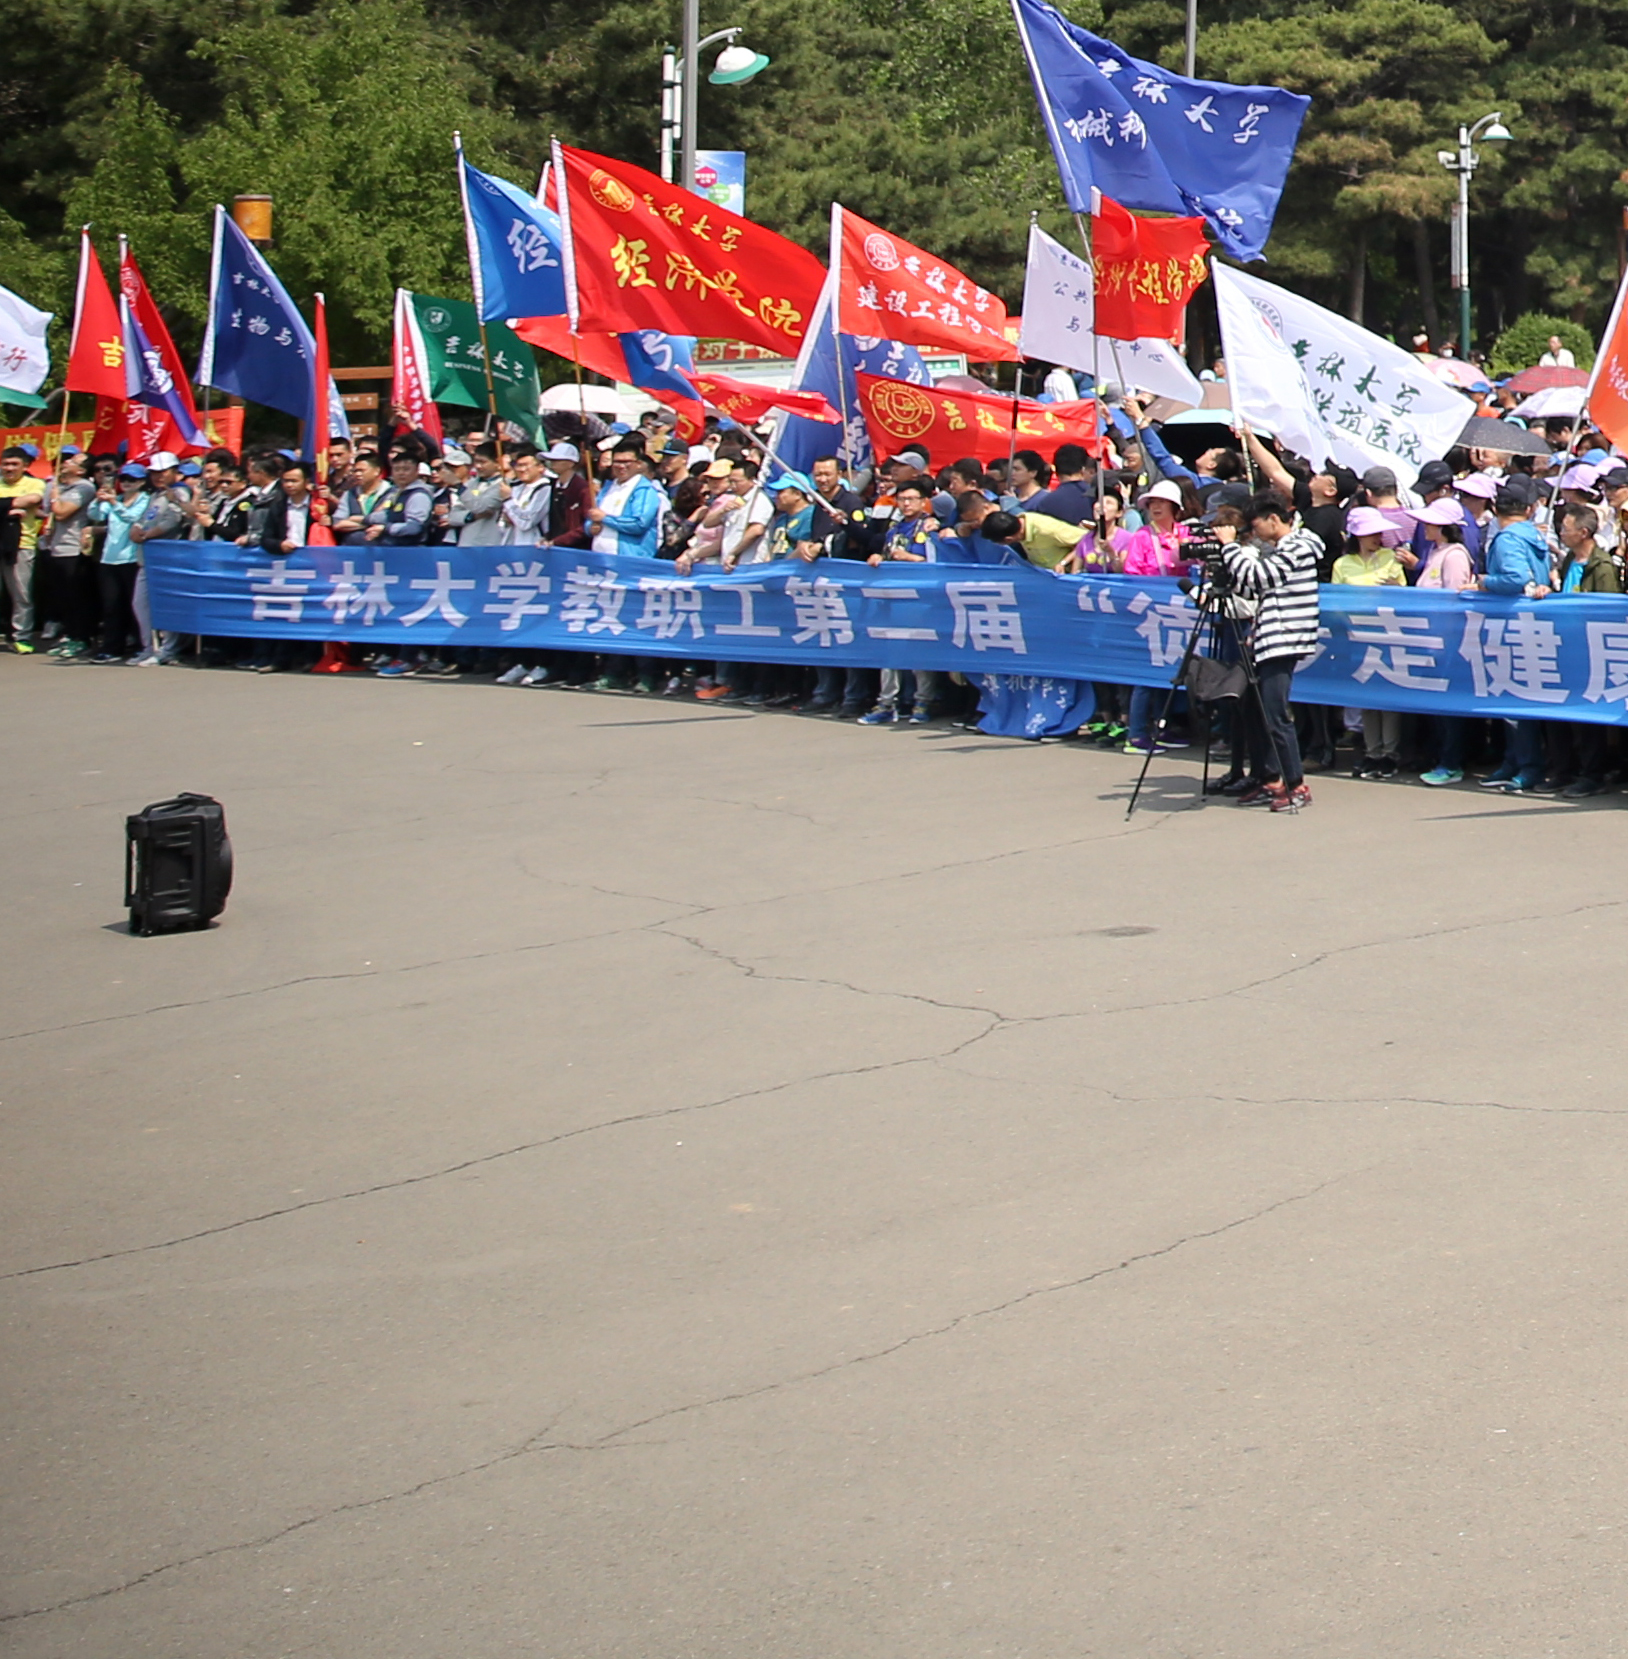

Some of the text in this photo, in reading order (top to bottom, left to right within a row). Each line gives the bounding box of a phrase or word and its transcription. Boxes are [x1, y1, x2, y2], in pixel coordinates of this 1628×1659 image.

[506, 217, 558, 275] 经
[642, 193, 743, 253] 吉林大学
[609, 233, 803, 338] 经济学院
[245, 559, 1029, 655] 吉林大学教职工第二届
